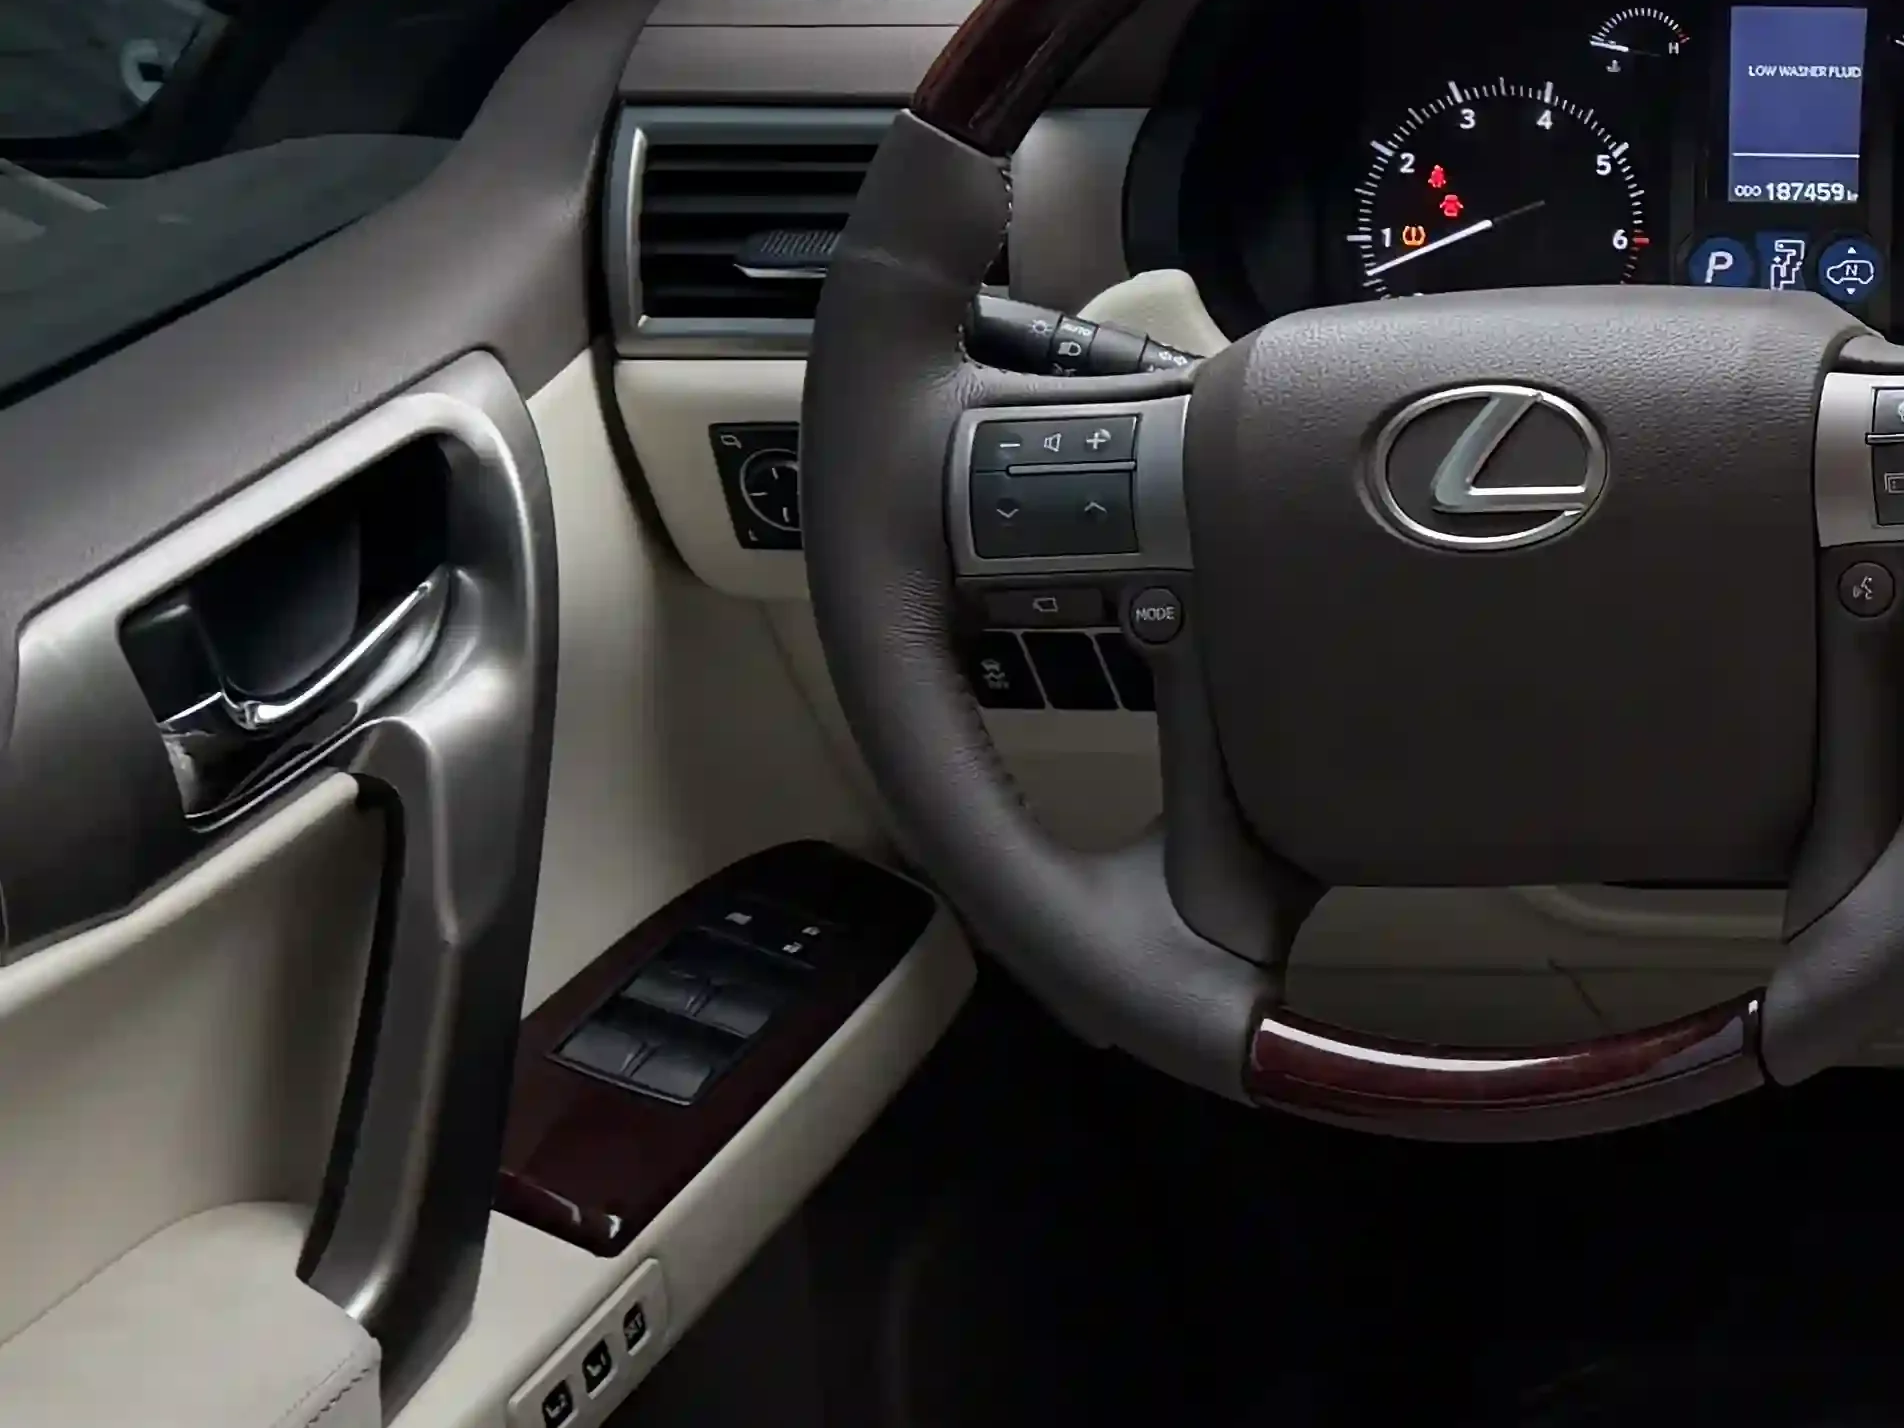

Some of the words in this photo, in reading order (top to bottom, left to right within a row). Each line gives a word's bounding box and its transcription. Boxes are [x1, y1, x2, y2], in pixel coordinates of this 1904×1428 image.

[1668, 42, 1679, 55] H
[1459, 108, 1476, 130] 3
[1536, 109, 1553, 130] 4
[1400, 152, 1415, 173] 2
[1596, 155, 1612, 176] 5
[1765, 182, 1844, 202] 187459
[1380, 227, 1391, 247] 1
[1612, 229, 1628, 250] 6
[1704, 251, 1734, 284] P
[1136, 606, 1175, 621] MODE
